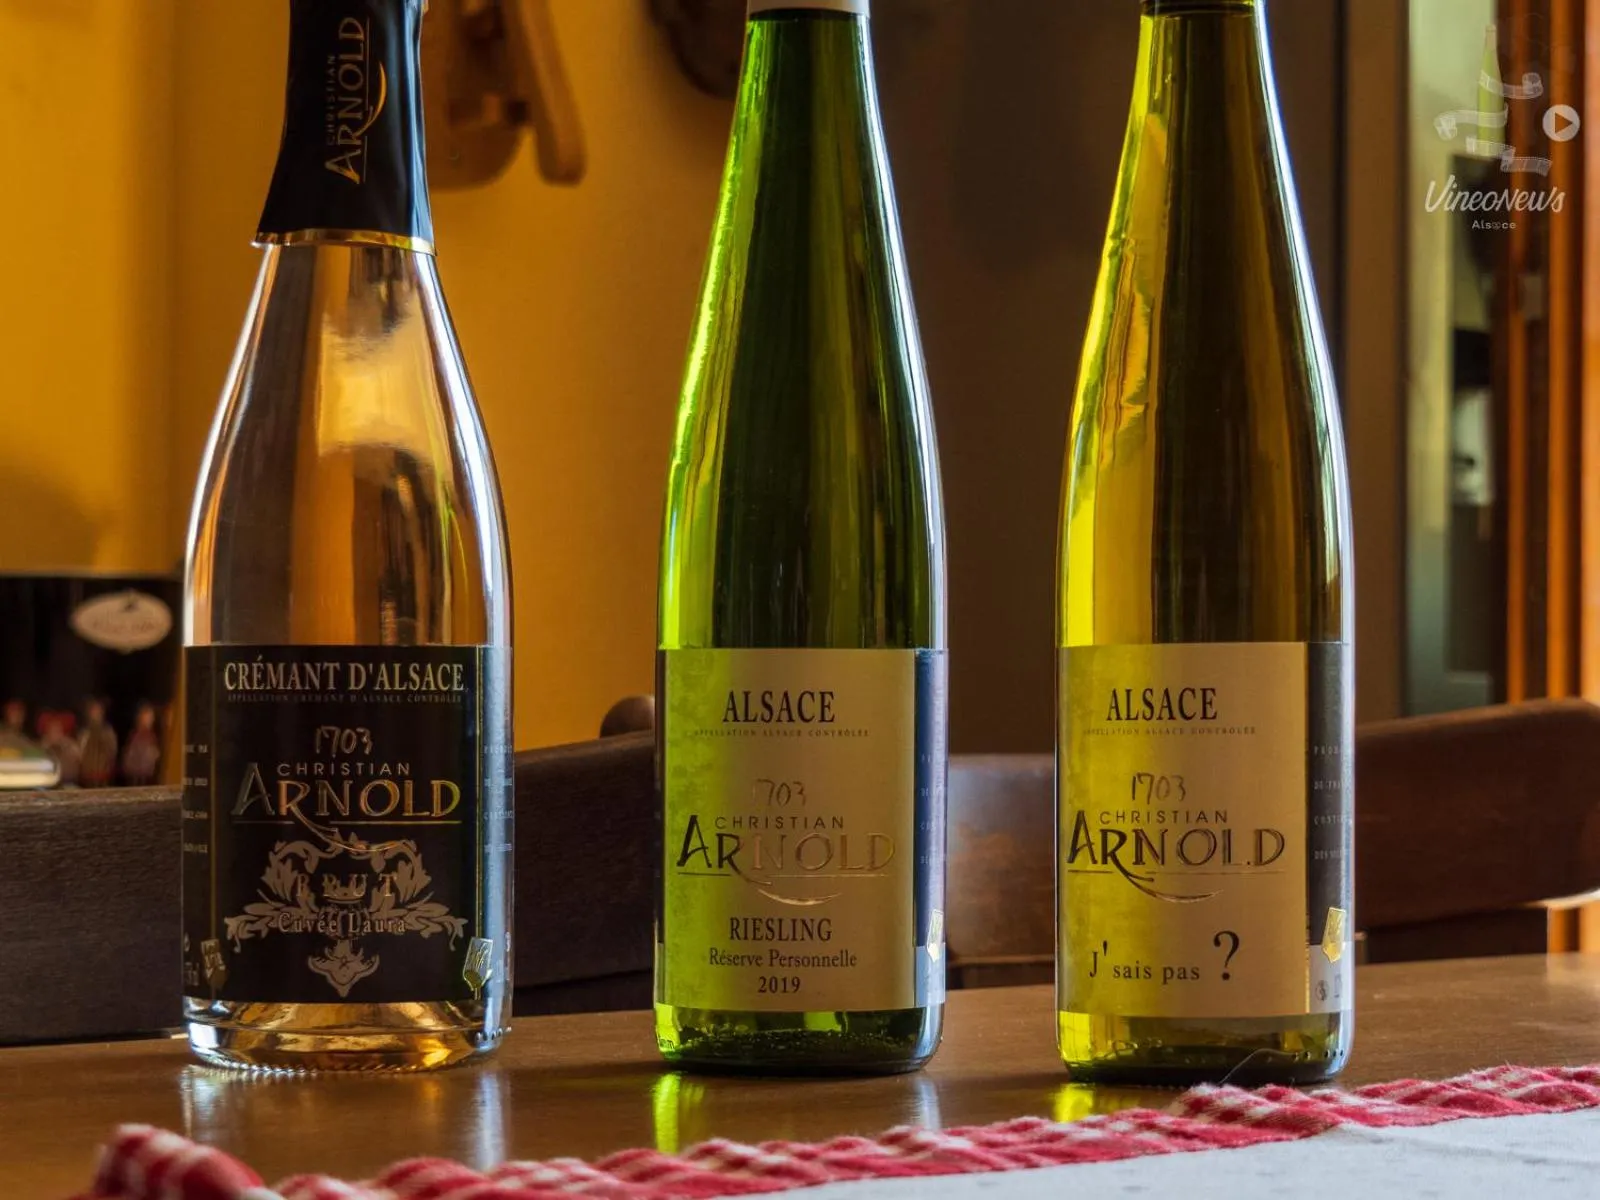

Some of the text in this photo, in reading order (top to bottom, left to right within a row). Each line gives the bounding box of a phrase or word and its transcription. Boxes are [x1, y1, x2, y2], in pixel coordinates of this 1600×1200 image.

[325, 16, 370, 185] ARNOLD
[224, 655, 465, 691] CRÉMANT D'ALSACE
[723, 690, 835, 723] ALSACE
[1106, 687, 1218, 721] ALSACE
[316, 725, 374, 758] 1703
[277, 761, 410, 777] CHRISTIAN
[231, 763, 462, 826] ARNOLD
[1131, 772, 1187, 805] 1703
[715, 815, 845, 830] CHRISTIAN
[1099, 810, 1229, 825] CHRISTIAN
[676, 814, 896, 876] ARNOLD
[1066, 810, 1286, 874] ARNOLD
[279, 911, 406, 933] Cuvée Laura
[729, 917, 833, 942] RIESLING
[708, 947, 858, 969] Réserve Personnelle
[1161, 964, 1201, 985] pas
[757, 976, 801, 994] 2019
